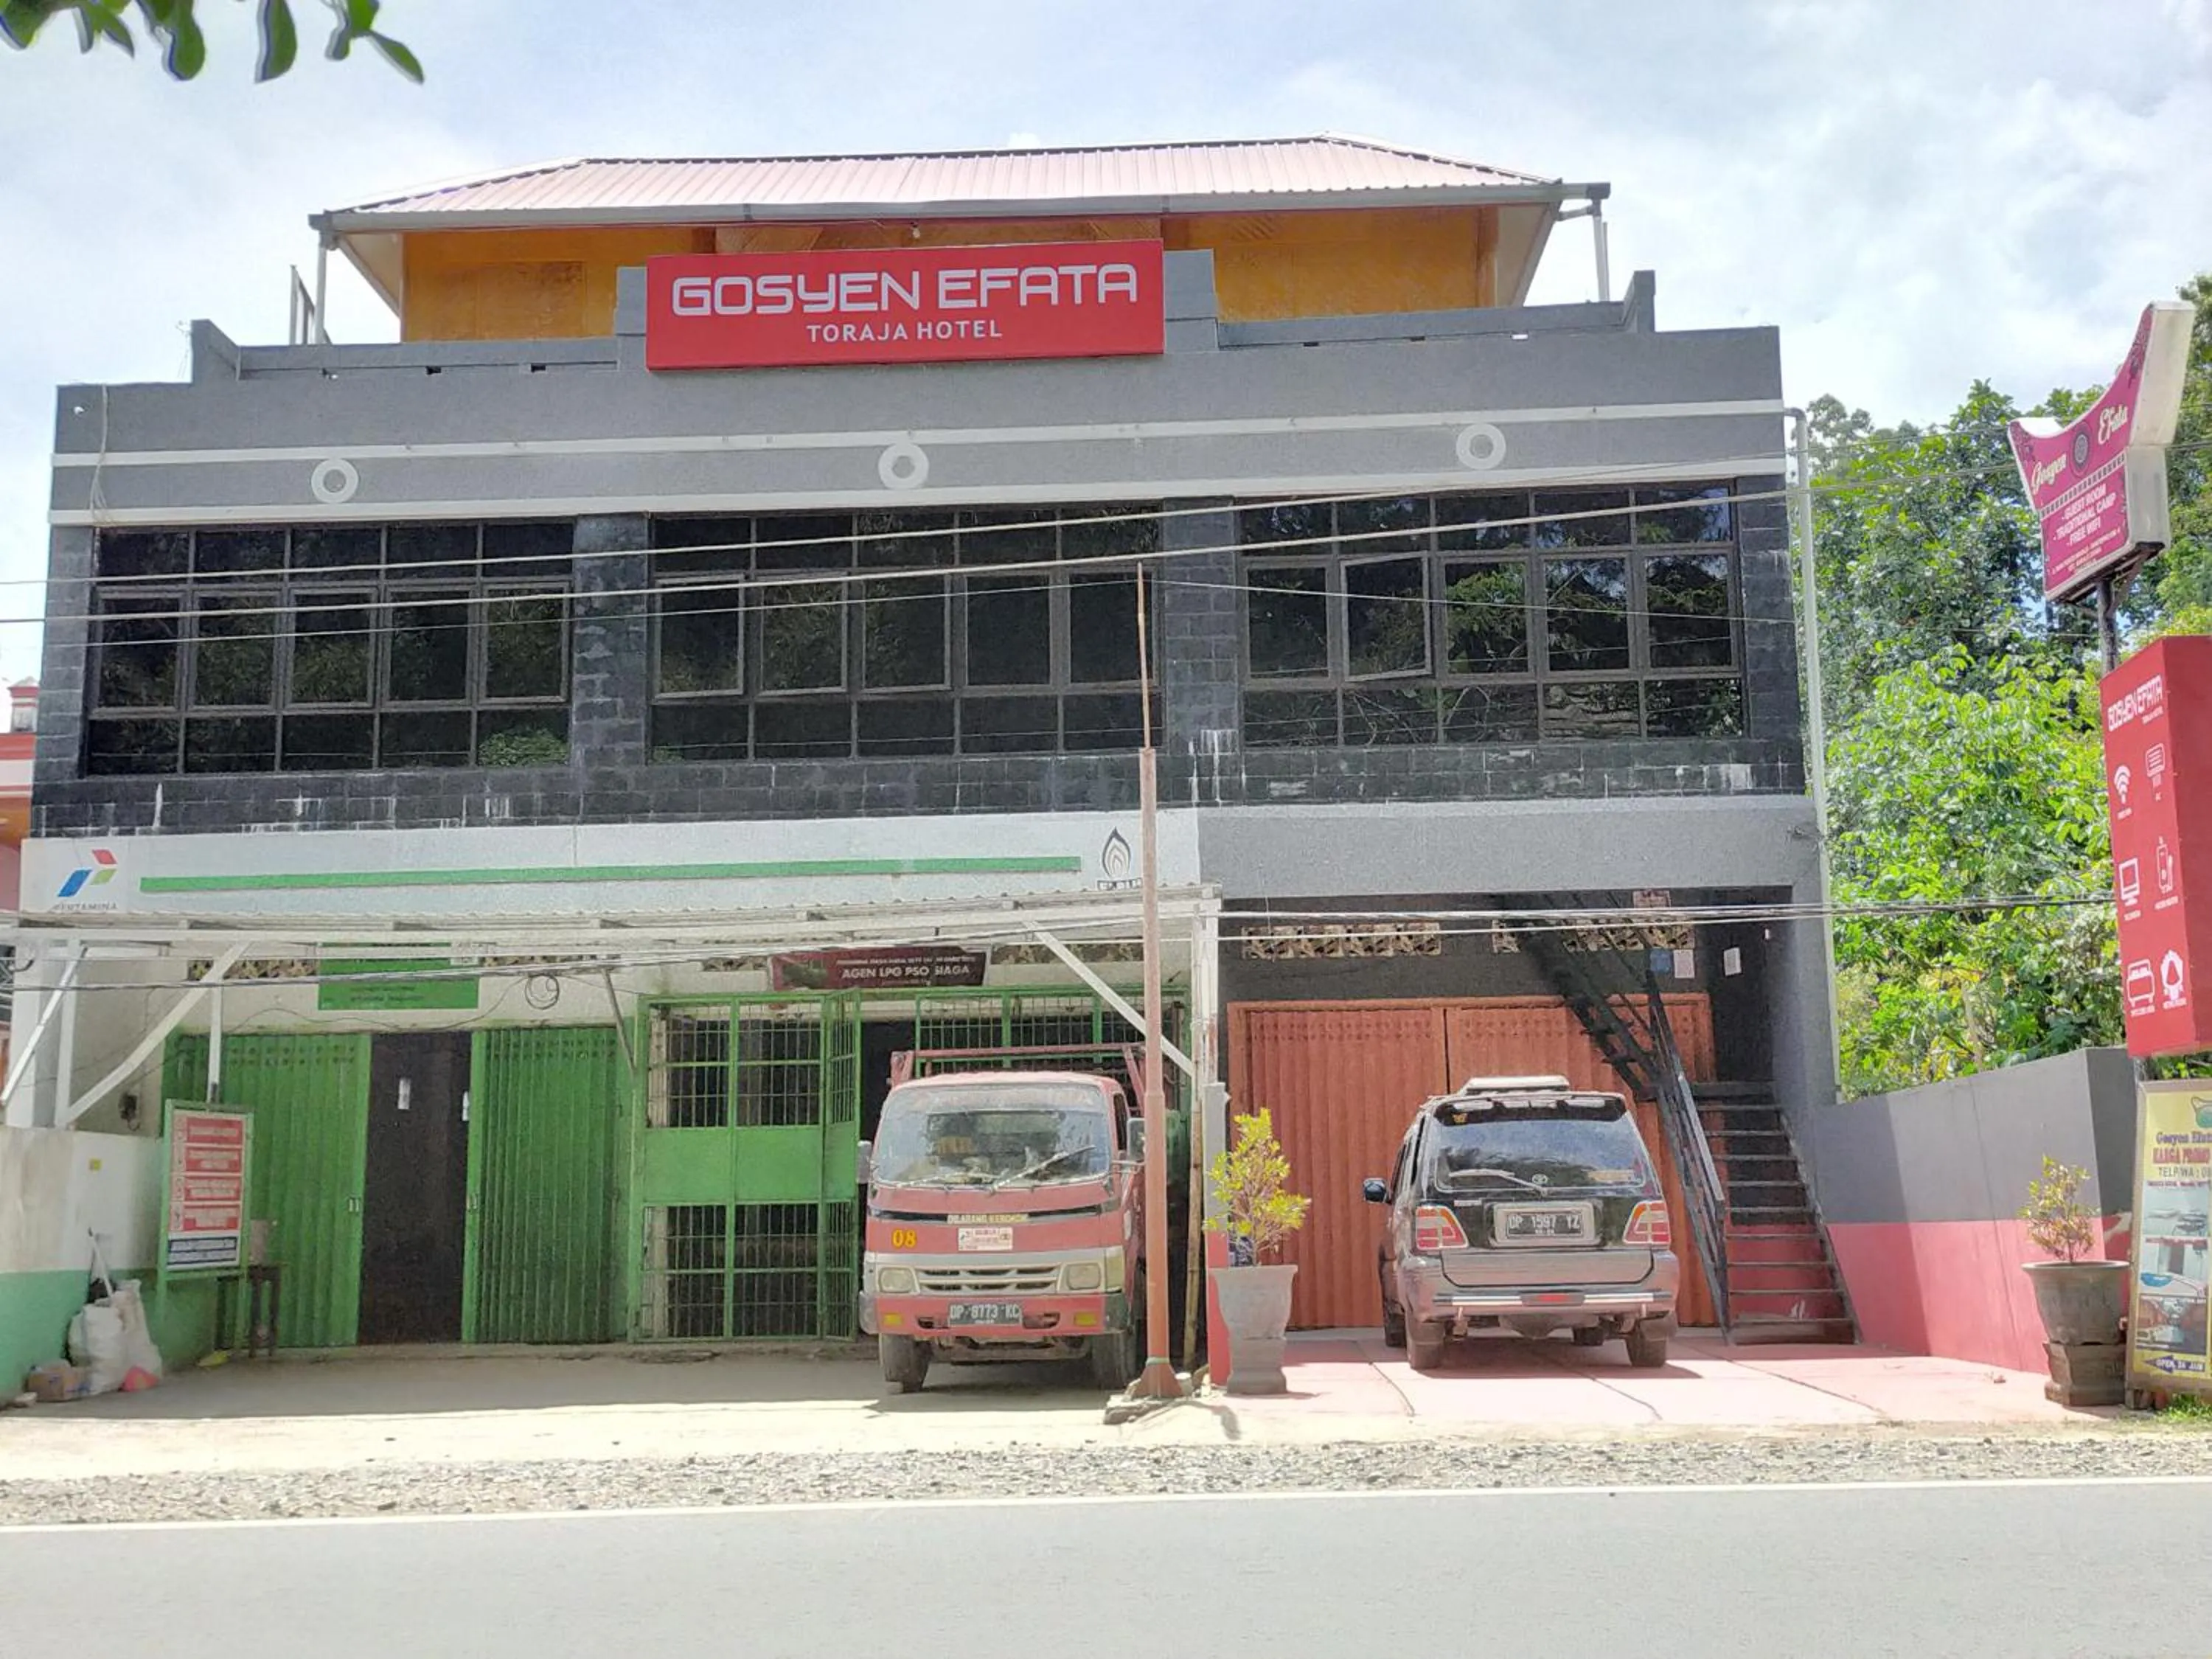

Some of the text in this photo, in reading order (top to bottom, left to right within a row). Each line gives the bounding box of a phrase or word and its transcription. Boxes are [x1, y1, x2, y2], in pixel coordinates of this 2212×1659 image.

[672, 263, 1138, 316] GOSYEN EFATA
[806, 319, 1003, 343] TORAJA HOTEL
[841, 967, 876, 979] AGEN
[878, 967, 902, 978] LPG
[905, 966, 930, 977] PSO
[892, 1229, 917, 1248] 08
